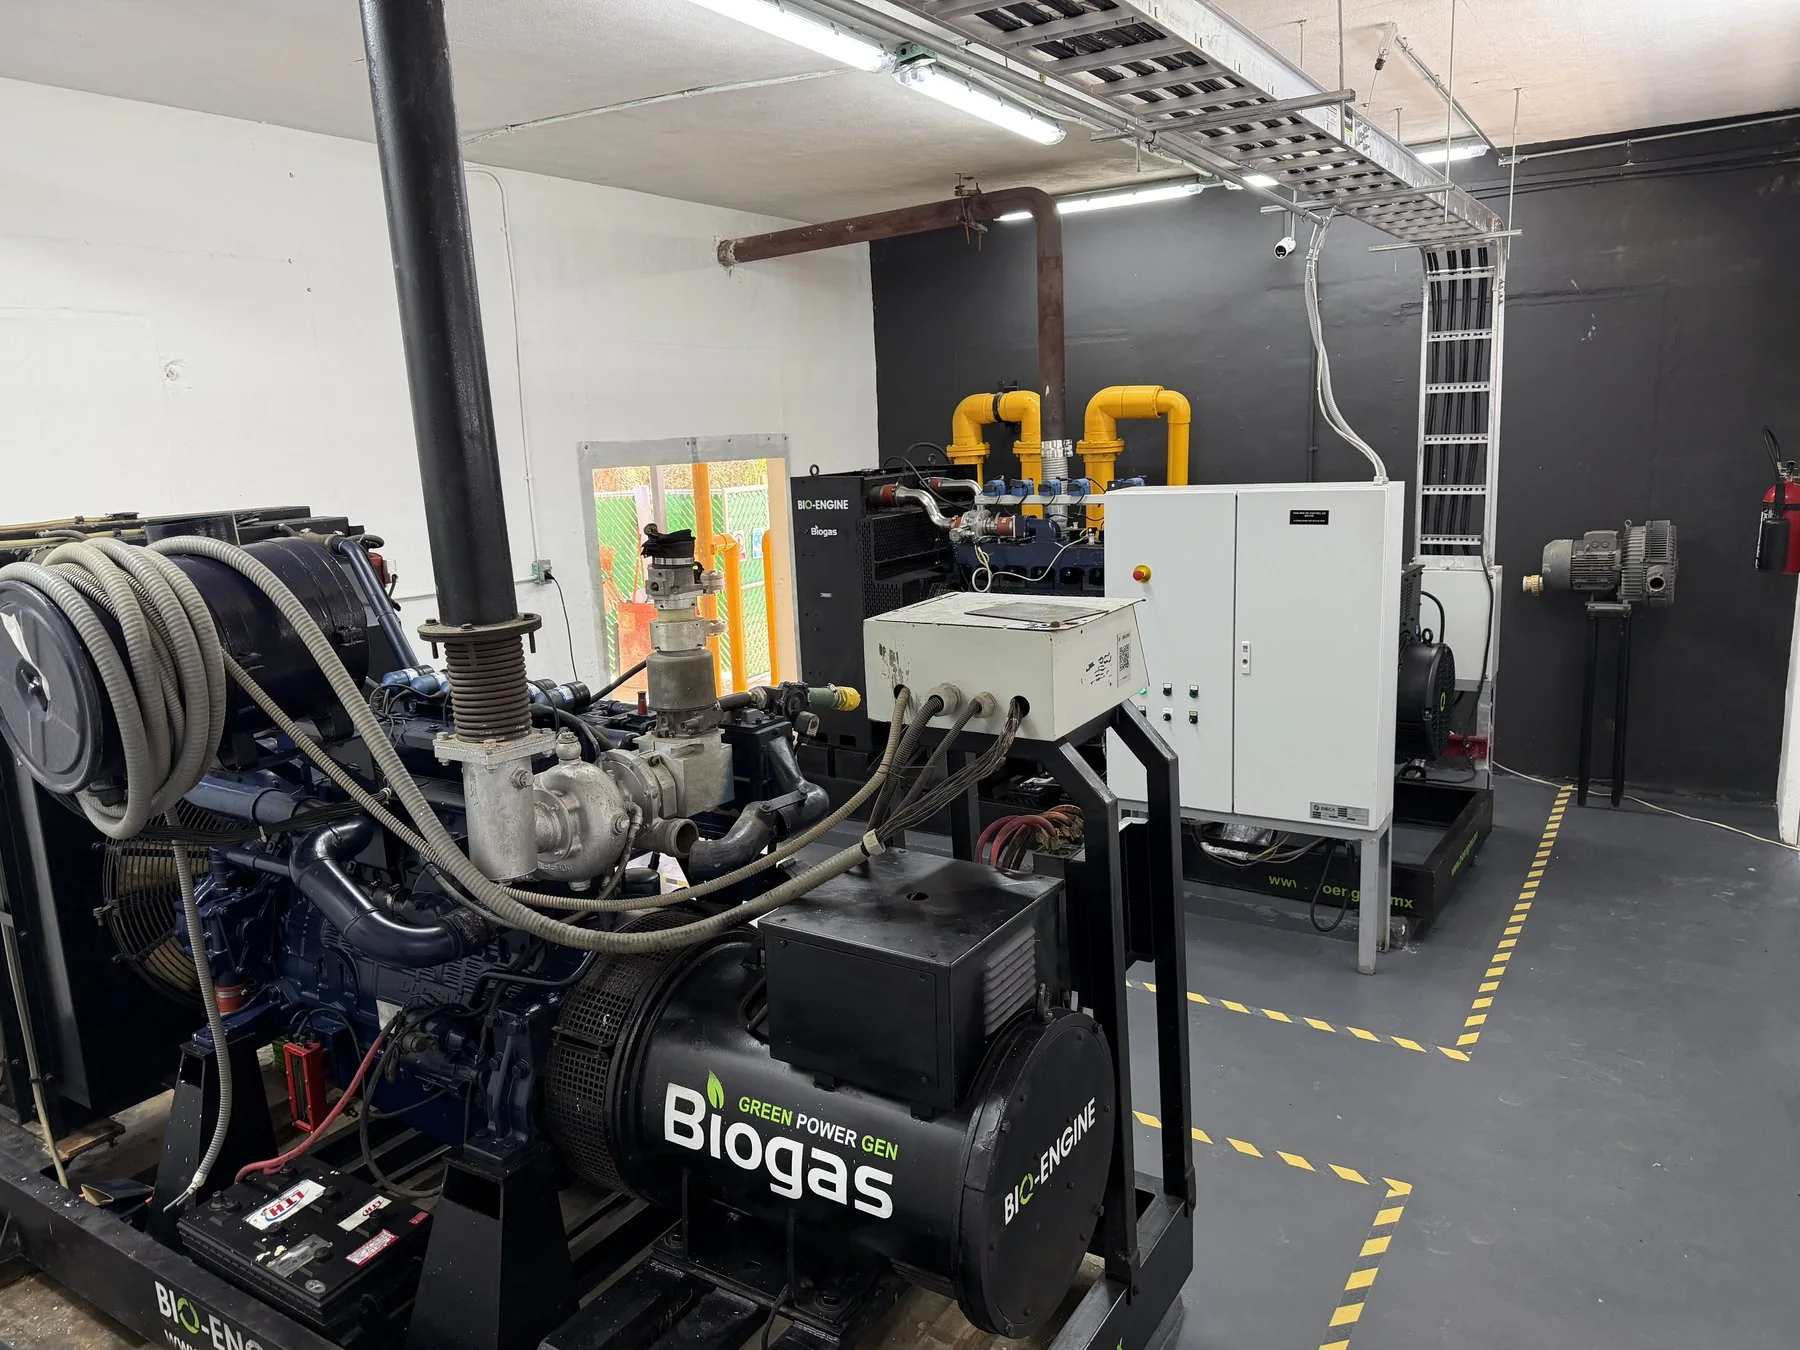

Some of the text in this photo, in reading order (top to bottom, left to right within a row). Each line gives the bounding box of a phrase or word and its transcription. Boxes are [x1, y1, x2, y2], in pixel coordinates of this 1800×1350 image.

[797, 499, 849, 510] BIO-ENGINE
[811, 525, 838, 538] Biogas
[664, 1070, 895, 1220] Biogas
[738, 1096, 899, 1161] GREEN POWER GEN
[1004, 1097, 1096, 1226] BIO-ENGINE
[269, 1190, 305, 1217] LTH
